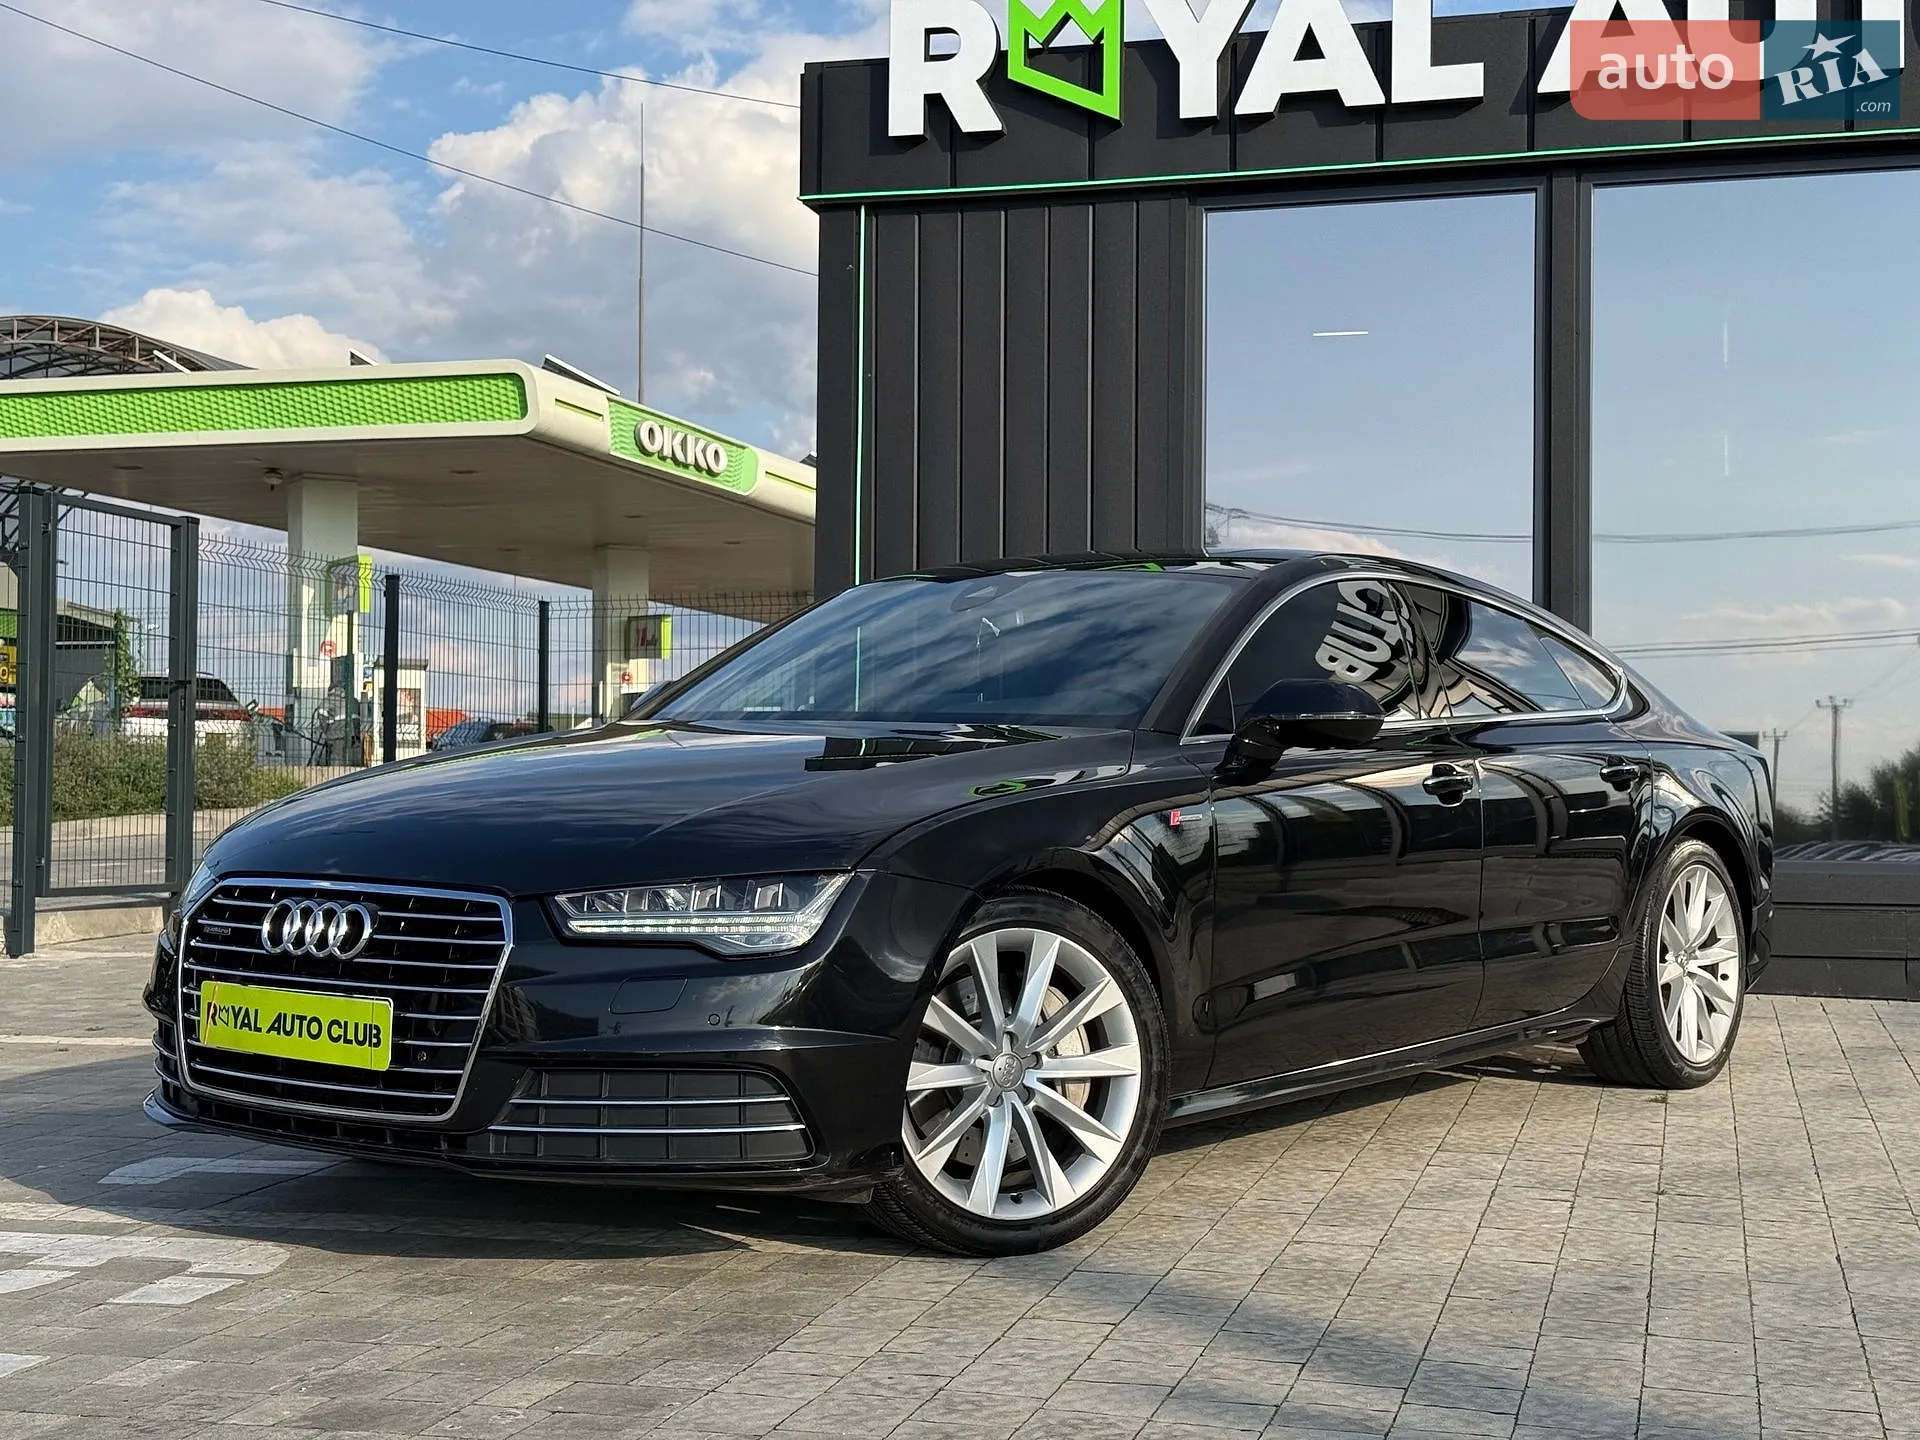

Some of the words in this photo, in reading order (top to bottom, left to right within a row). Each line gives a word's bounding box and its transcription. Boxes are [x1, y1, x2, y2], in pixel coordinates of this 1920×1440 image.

[636, 420, 728, 474] OKKO
[265, 1011, 323, 1041] AUTO
[327, 1018, 382, 1049] CLUB
